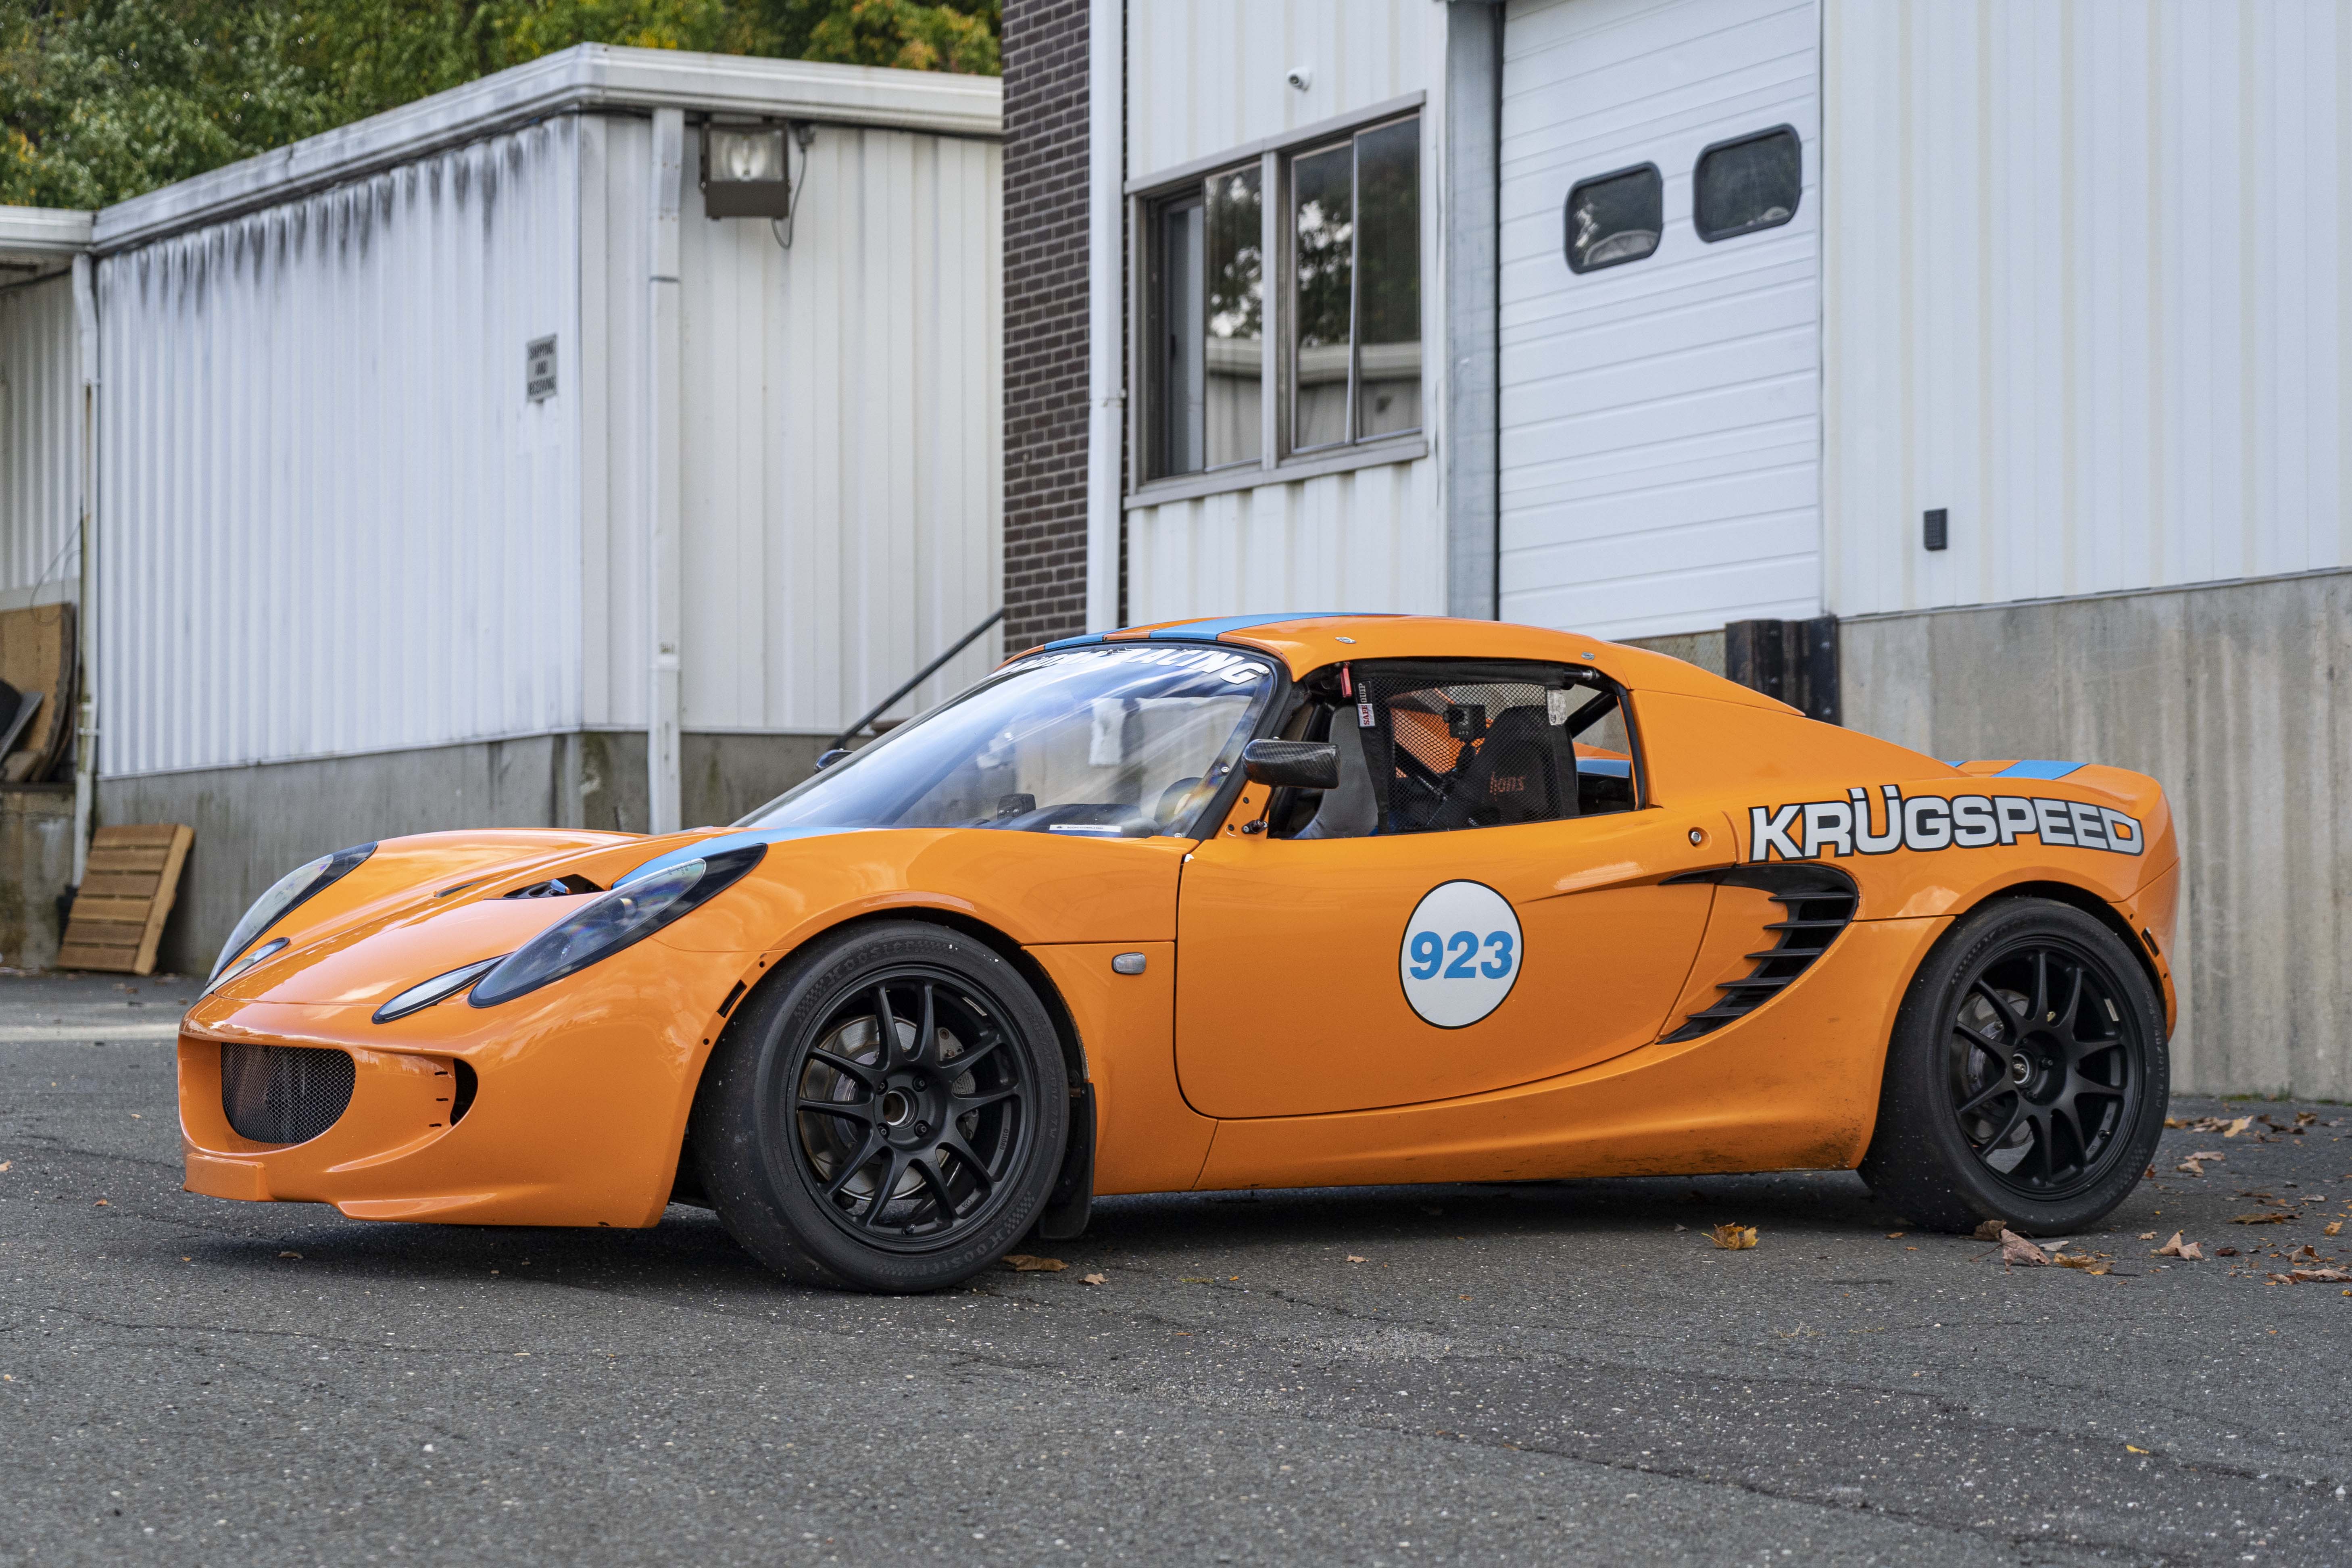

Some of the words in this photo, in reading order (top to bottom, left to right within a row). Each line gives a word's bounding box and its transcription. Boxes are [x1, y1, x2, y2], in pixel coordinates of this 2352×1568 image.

[1112, 647, 1264, 684] RACING
[1749, 785, 2144, 862] KRÜGSPEED
[1410, 930, 1514, 980] 923
